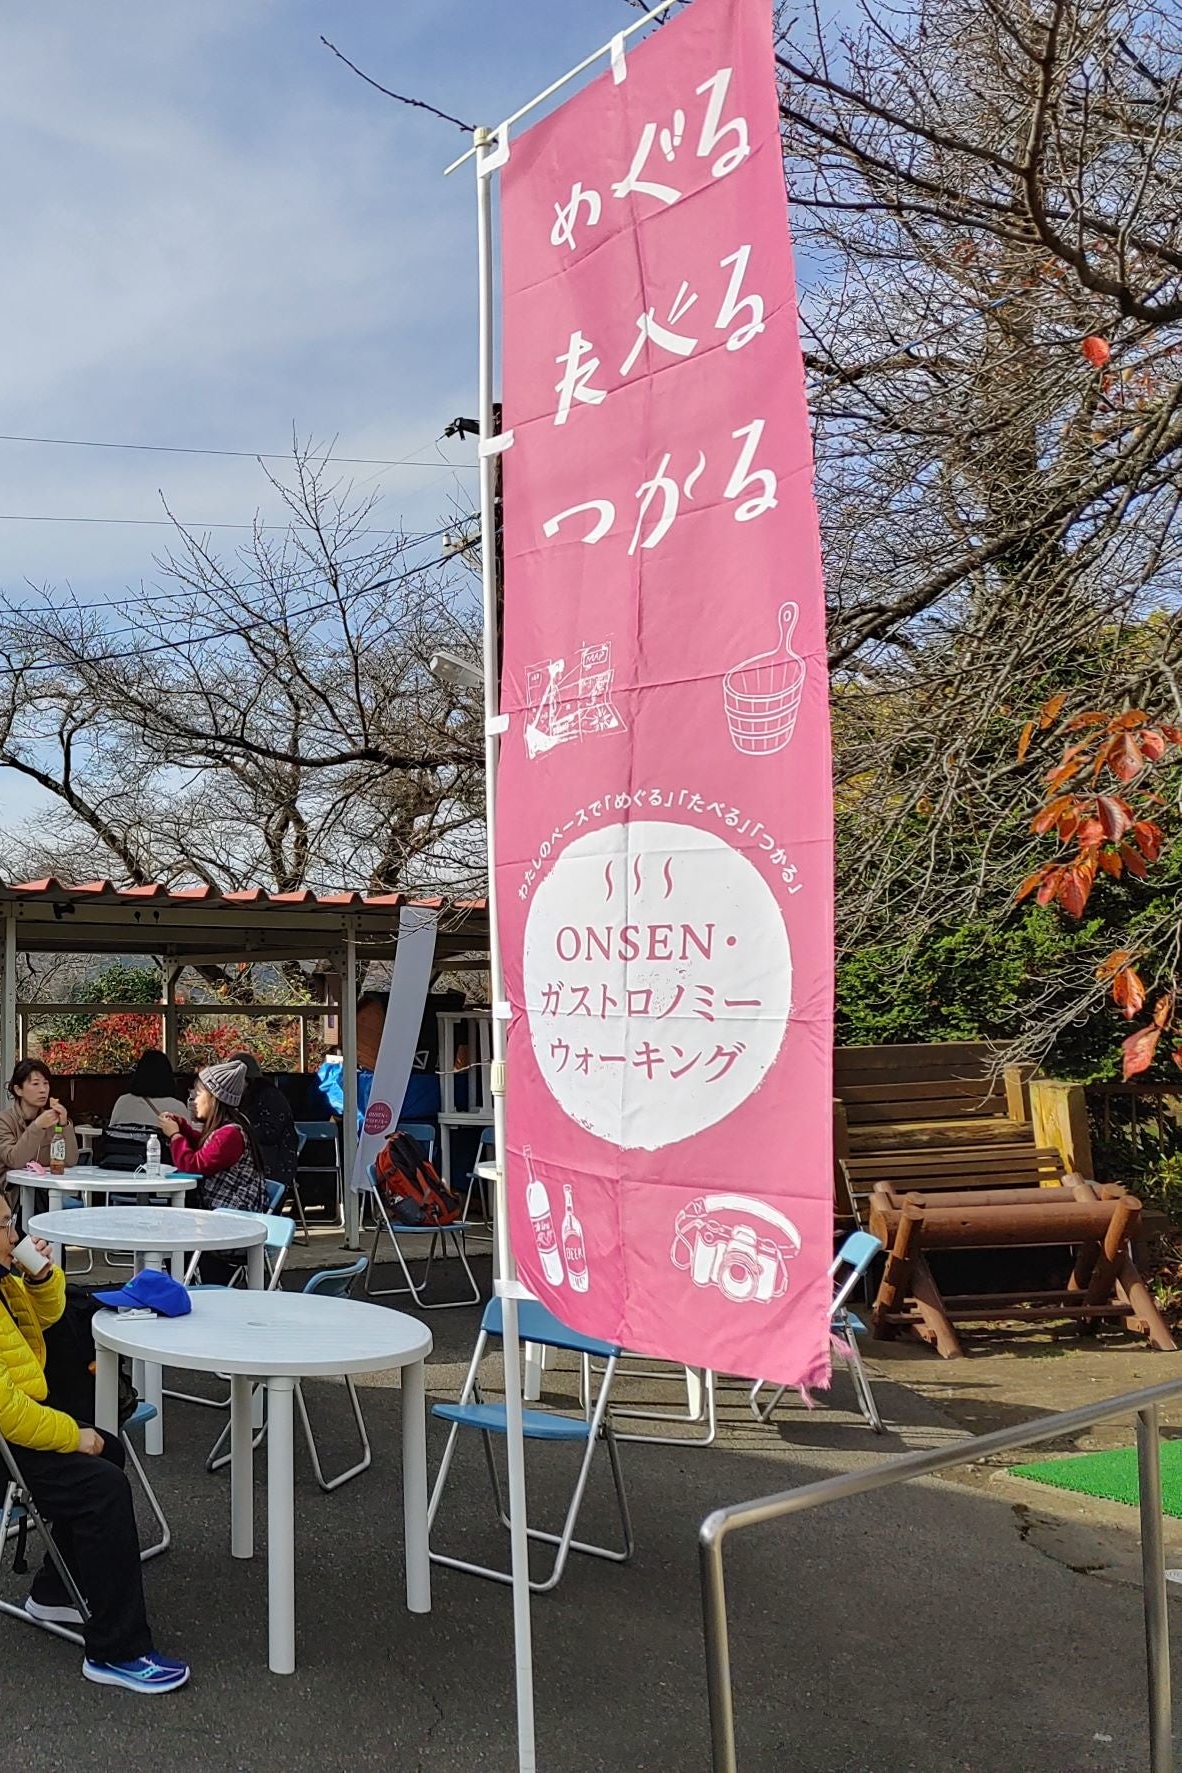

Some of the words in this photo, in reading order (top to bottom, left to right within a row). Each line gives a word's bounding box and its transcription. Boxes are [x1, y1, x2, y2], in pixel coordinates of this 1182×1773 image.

[550, 67, 751, 249] めぐる
[554, 244, 766, 426] たべる
[543, 419, 779, 555] つかる
[540, 981, 763, 1023] ガストロノミー
[549, 1039, 748, 1084] ウォーキング
